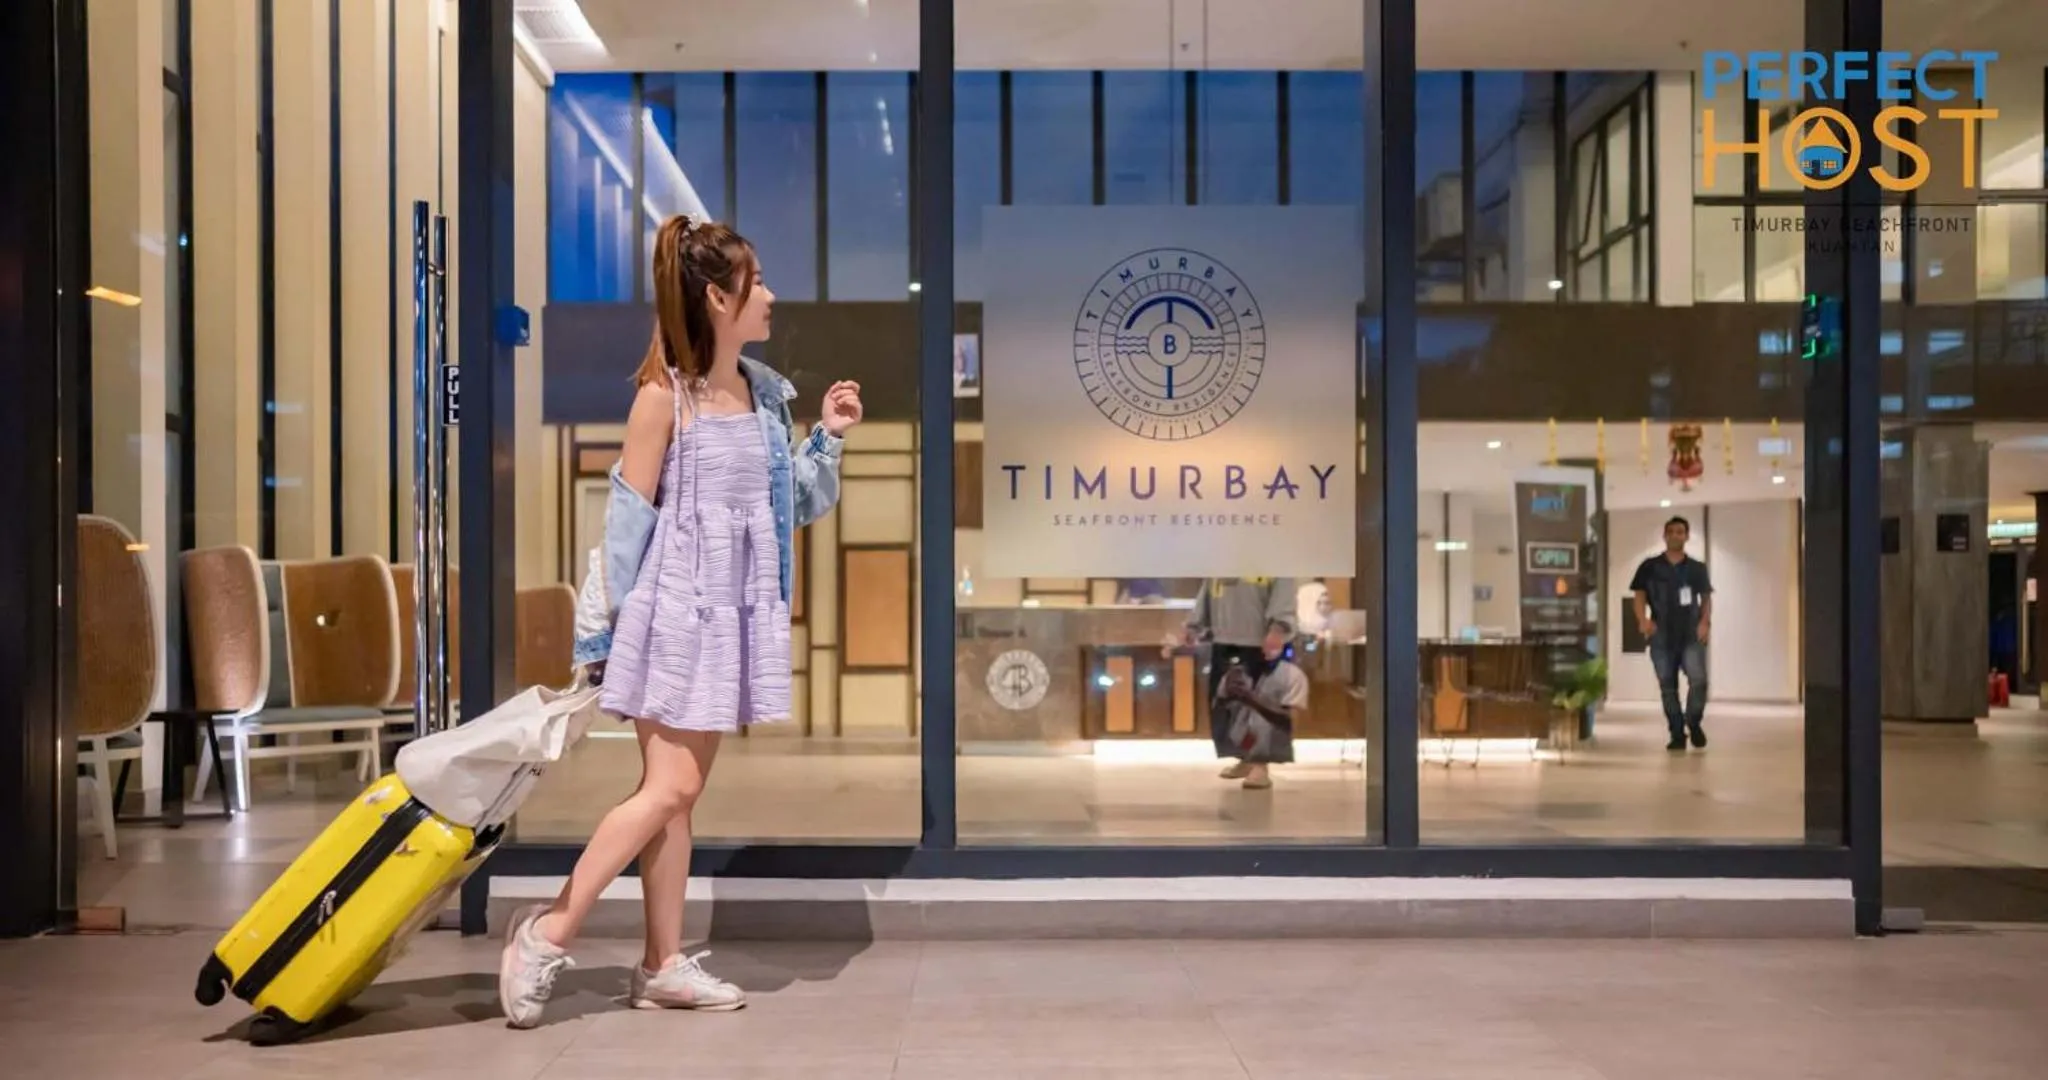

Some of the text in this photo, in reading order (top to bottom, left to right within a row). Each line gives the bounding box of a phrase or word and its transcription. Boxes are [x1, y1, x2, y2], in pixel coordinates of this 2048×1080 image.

[1086, 256, 1255, 321] TIMURBAY
[447, 366, 460, 424] PULL
[1103, 351, 1162, 411] SEAFRONT
[1002, 465, 1336, 500] TIMURBAY
[1053, 514, 1282, 527] SEAFRONT RESIDENCE
